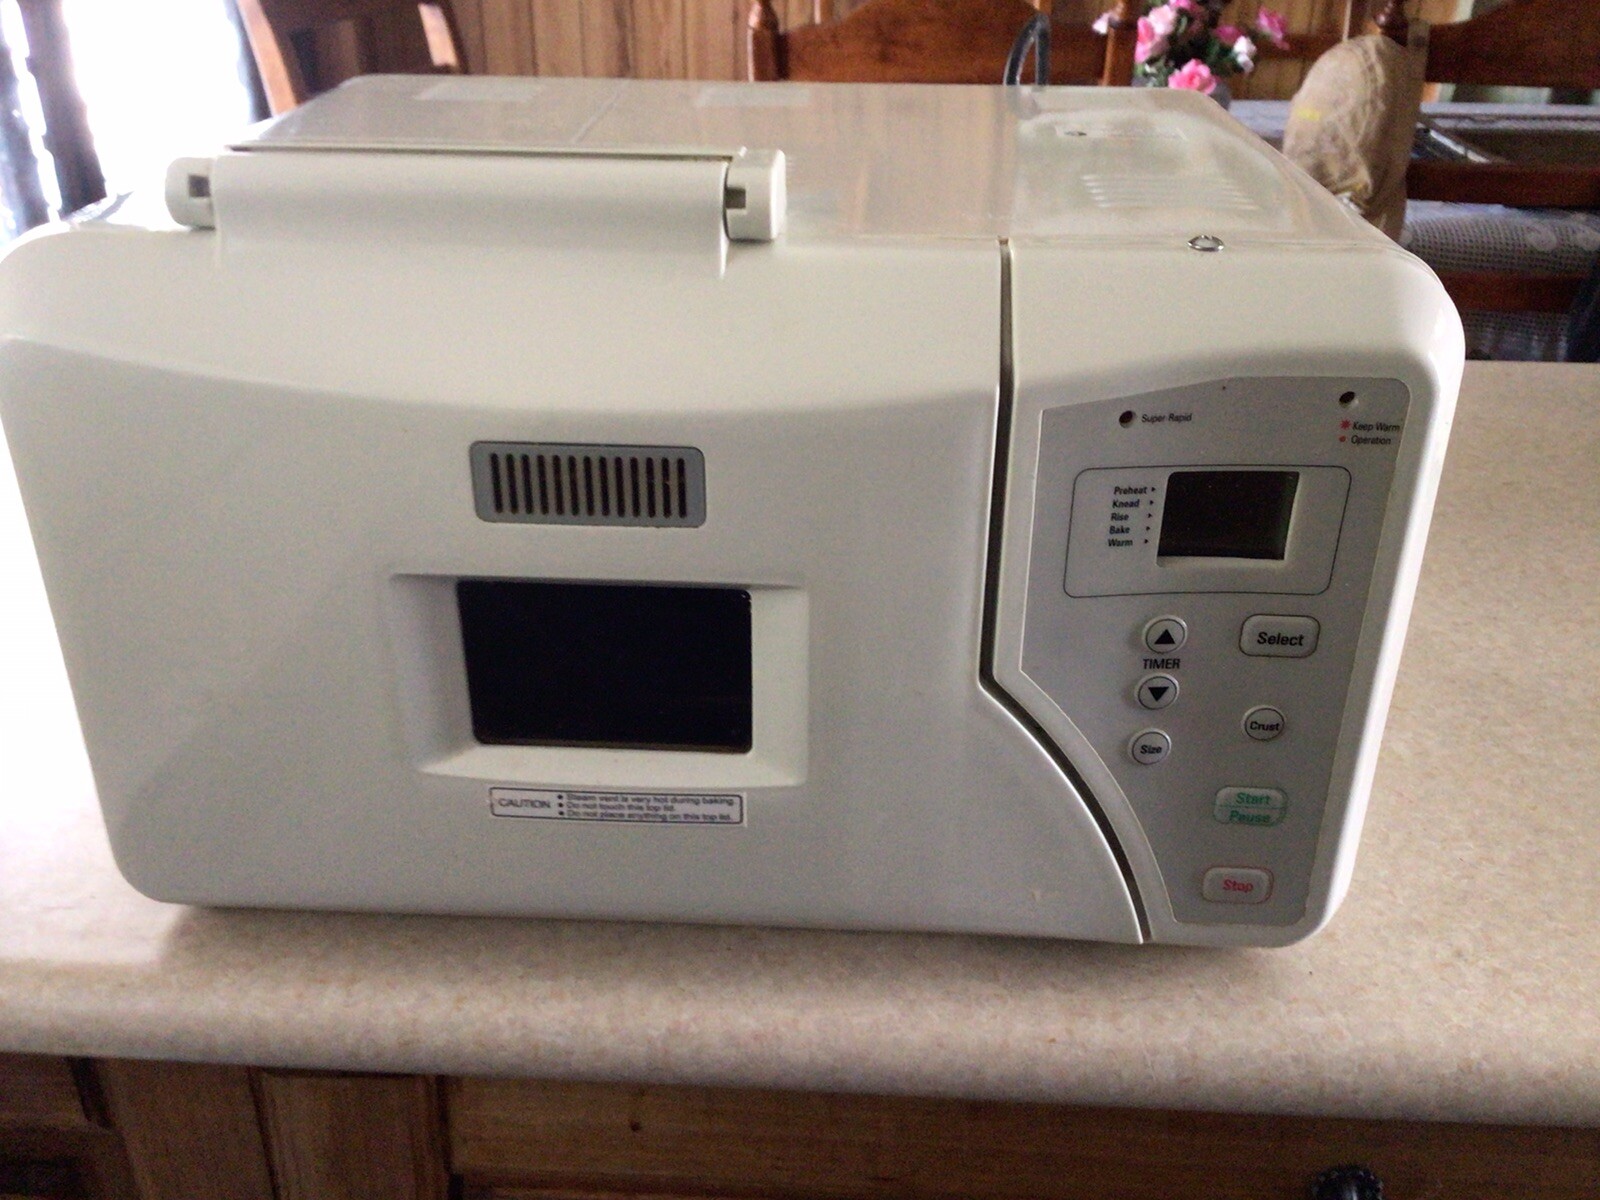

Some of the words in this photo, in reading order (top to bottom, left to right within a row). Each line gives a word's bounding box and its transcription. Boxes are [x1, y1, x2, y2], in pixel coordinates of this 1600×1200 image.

[1141, 413, 1165, 424] Super
[1168, 412, 1193, 423] Rapid
[1352, 421, 1374, 432] Keep
[1376, 421, 1401, 432] Warm
[1351, 434, 1392, 446] Operation
[1113, 485, 1148, 495] Preheat
[1112, 498, 1140, 508] Knead
[1110, 512, 1130, 521] Rise
[1109, 525, 1130, 534] Bake
[1107, 538, 1133, 547] Warm
[1257, 632, 1304, 647] Select
[1143, 658, 1181, 670] TIMER
[1249, 720, 1280, 732] Crust
[1140, 744, 1163, 755] Size
[1235, 791, 1271, 805] Start
[1229, 809, 1271, 823] Pause
[1222, 878, 1254, 893] Stop
